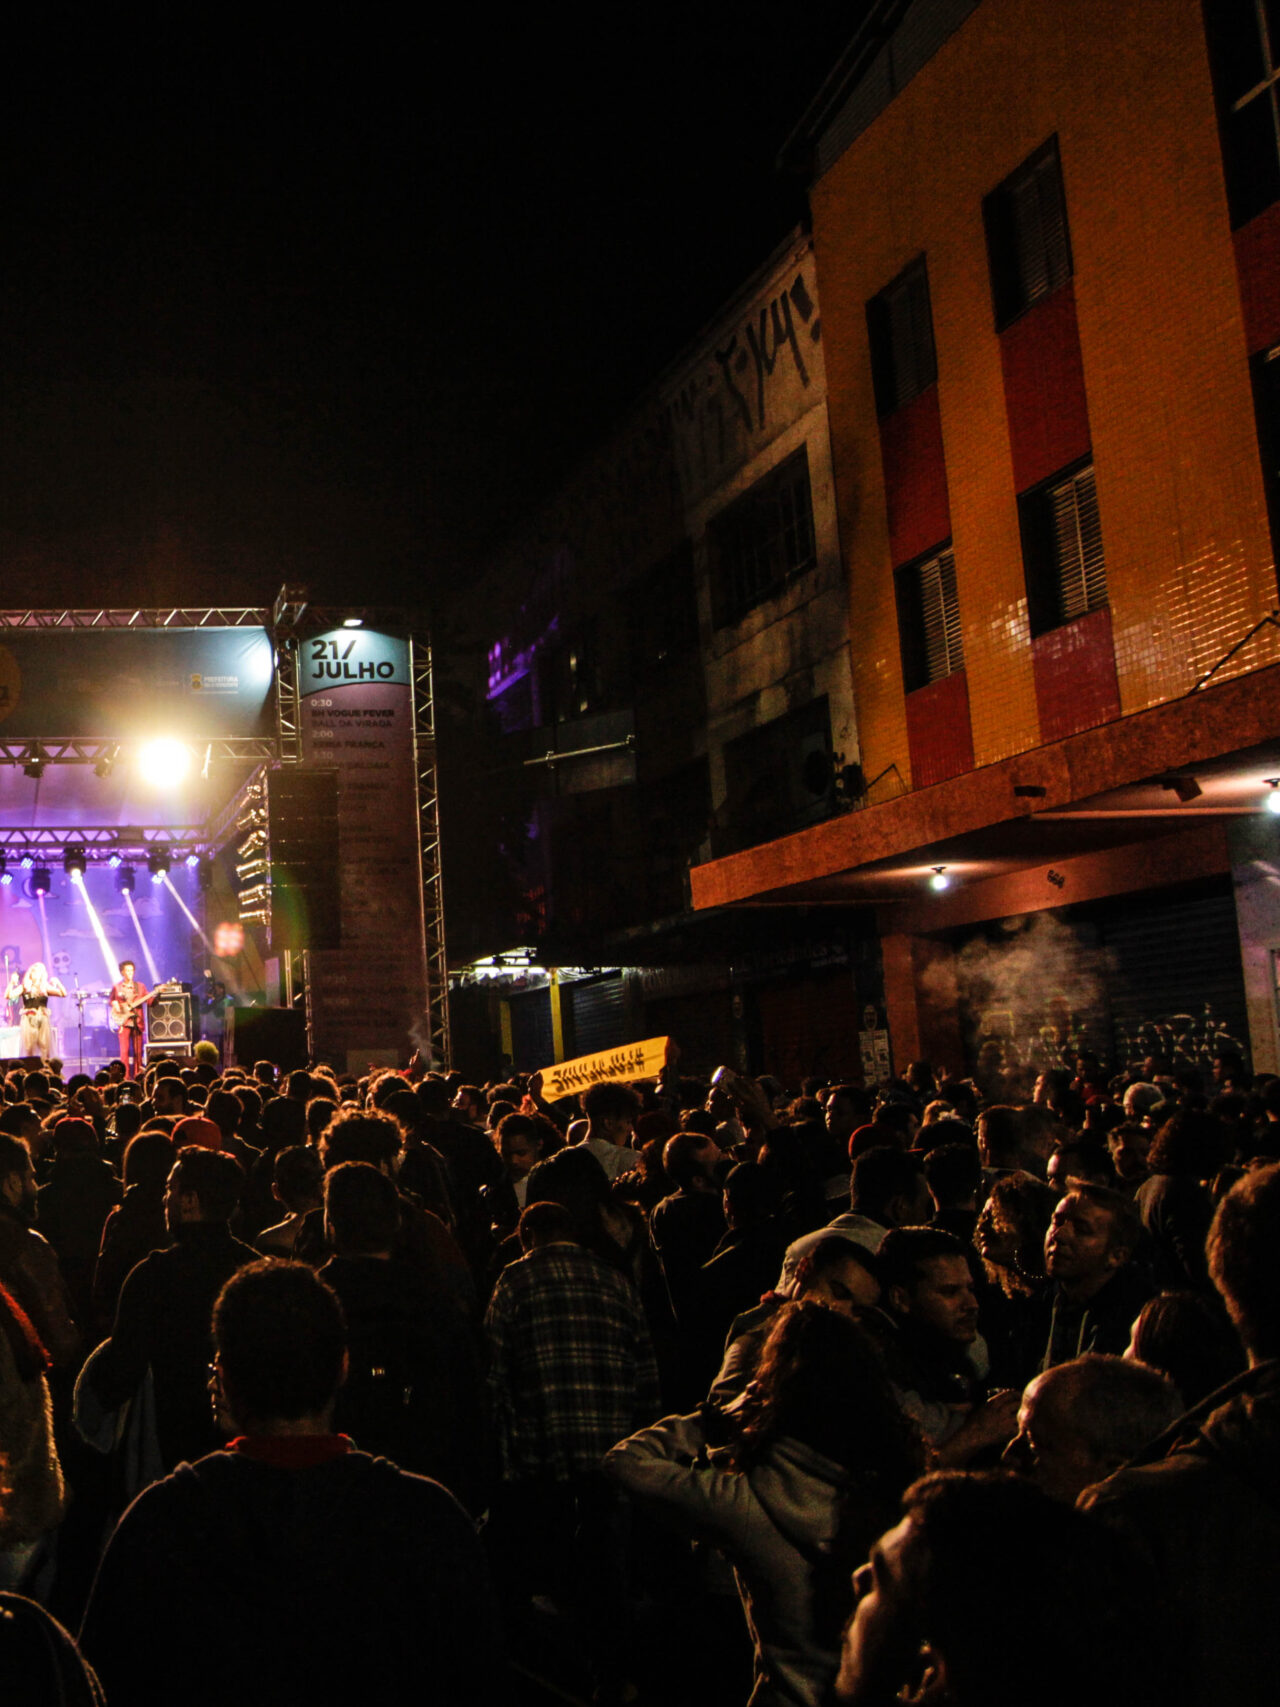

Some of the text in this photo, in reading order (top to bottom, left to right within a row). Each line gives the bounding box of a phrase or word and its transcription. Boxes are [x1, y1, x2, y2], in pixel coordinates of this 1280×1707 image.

[312, 640, 356, 660] 21/
[312, 661, 394, 679] JULHO
[311, 699, 333, 707] 0:30
[327, 709, 361, 717] VOGUE
[364, 709, 394, 718] FEVER
